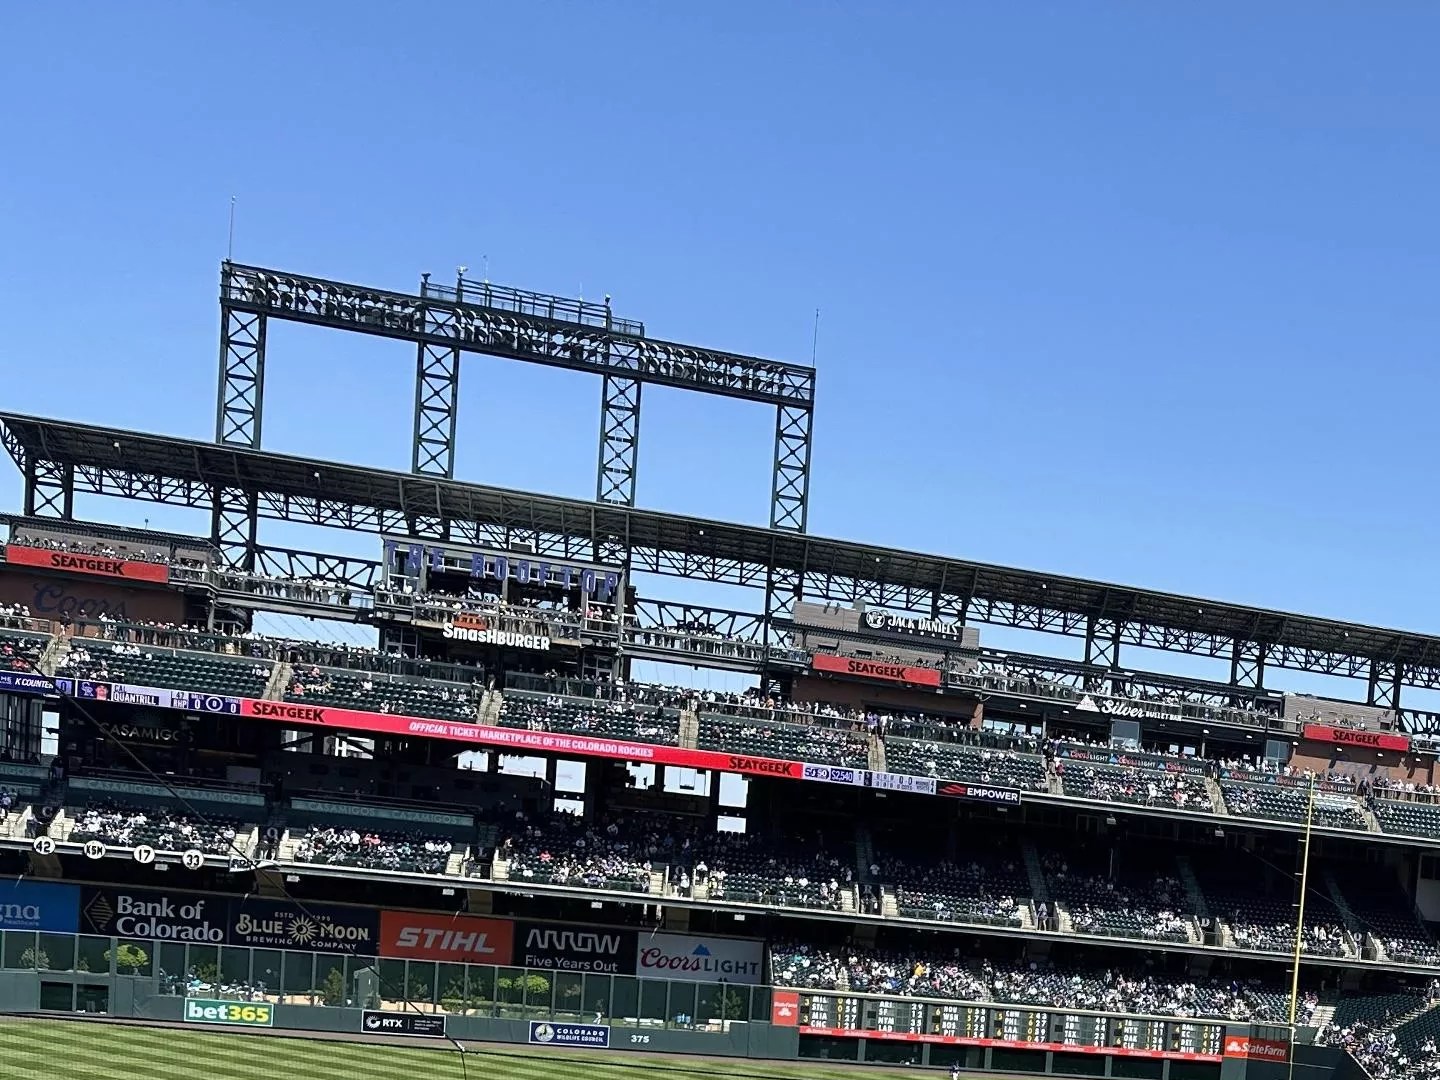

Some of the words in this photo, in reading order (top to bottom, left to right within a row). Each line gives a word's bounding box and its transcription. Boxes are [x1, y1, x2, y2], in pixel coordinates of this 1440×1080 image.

[51, 553, 125, 576] SEATGEEK
[385, 540, 445, 573] THE
[471, 552, 619, 596] ROOFTOP
[888, 614, 915, 629] JACK
[848, 660, 906, 680] SEATGEEK
[15, 678, 22, 686] K
[21, 678, 54, 689] COUNTER
[113, 691, 157, 705] QUANTRILL
[173, 698, 187, 708] RHP
[194, 700, 201, 709] 0
[230, 704, 237, 713] 0
[251, 701, 326, 723] SEATGEEK
[1101, 699, 1144, 718] Silver
[409, 721, 448, 735] OFFICIAL
[449, 725, 480, 738] TICKET
[480, 729, 542, 745] MARKETPLACE
[543, 736, 554, 747] OF
[555, 738, 571, 749] THE
[572, 740, 617, 754] COLORADO
[618, 746, 654, 758] ROCKIES
[1333, 729, 1380, 746] SEATGEEK
[1089, 751, 1109, 761] LIGHT
[729, 757, 793, 776] SEATGEEK
[1185, 765, 1203, 774] LIGHT
[1249, 774, 1267, 782] LIGHT
[87, 780, 161, 794] CASAMIGOS
[966, 787, 1018, 801] EMPOWER
[309, 801, 376, 816] CASAMIGOS
[35, 841, 51, 853] 42
[138, 849, 151, 862] 17
[186, 853, 201, 867] 33
[117, 895, 176, 918] Bank
[179, 900, 205, 920] of
[274, 911, 294, 919] ESTD
[116, 916, 224, 942] Colorado
[235, 913, 284, 935] BLUE
[320, 921, 369, 941] MOON
[245, 935, 293, 945] BREWING
[310, 940, 357, 950] COMPANY
[395, 926, 496, 954] STIHL
[525, 928, 621, 954] ARROW
[525, 954, 553, 967] Five
[554, 956, 591, 970] Years
[593, 959, 619, 973] Out
[640, 947, 701, 972] Coors
[703, 958, 760, 976] LIGHT
[812, 996, 827, 1004] MIL
[812, 1003, 823, 1011] STL
[188, 1002, 269, 1022] bet365
[811, 1012, 827, 1020] MIA
[382, 1018, 403, 1028] RTX
[810, 1020, 827, 1028] CHC
[556, 1028, 605, 1037] COLORADO
[630, 1034, 650, 1044] 375
